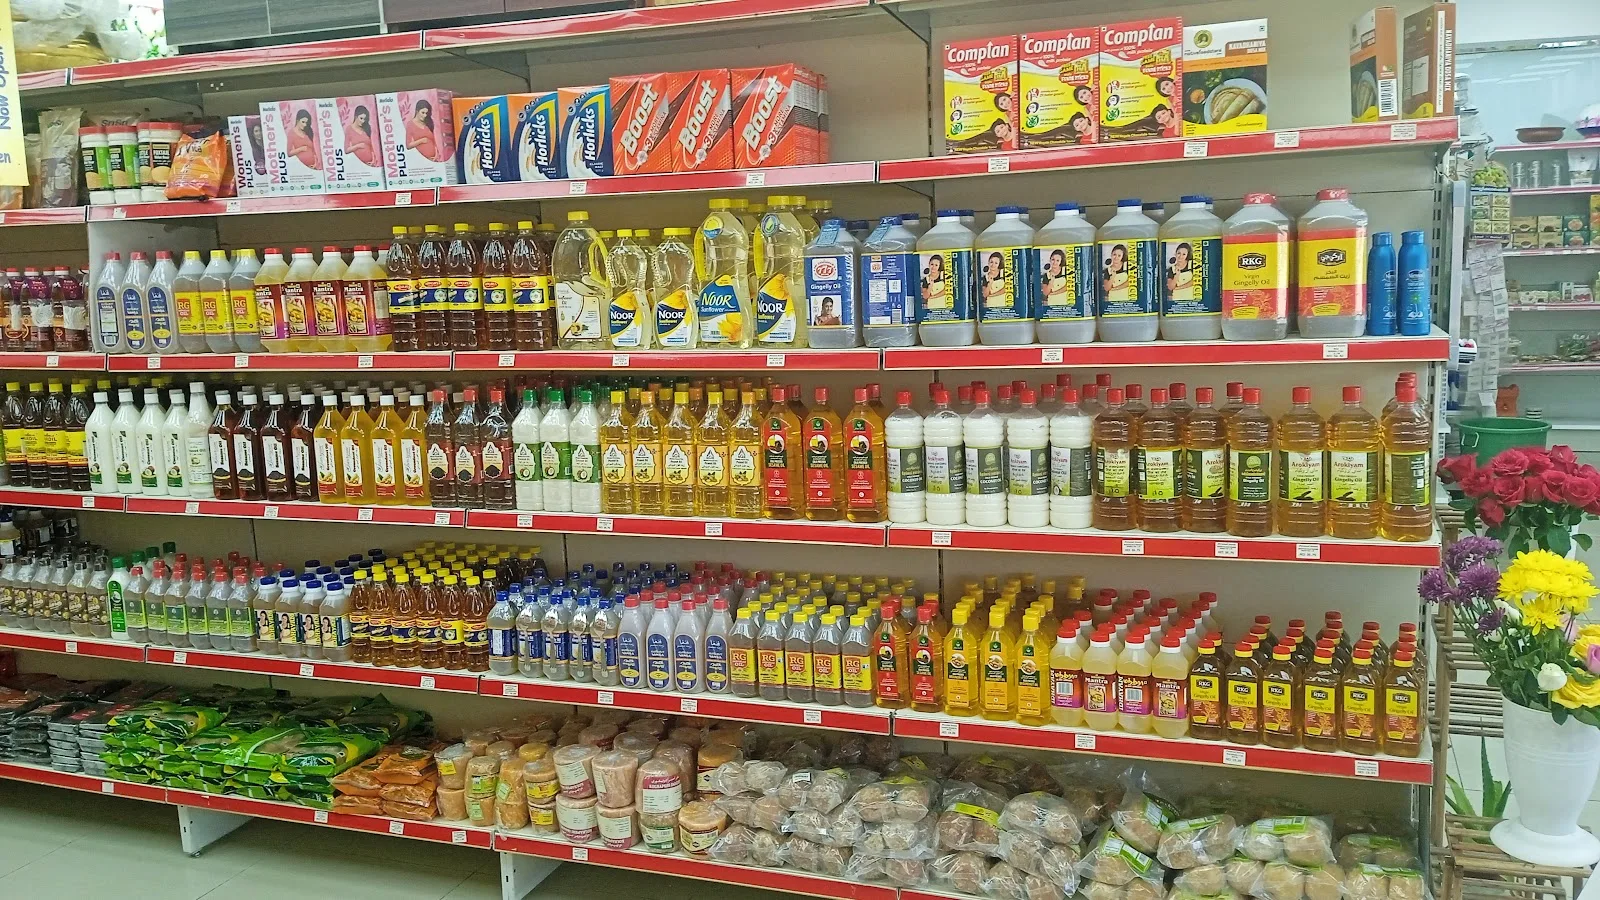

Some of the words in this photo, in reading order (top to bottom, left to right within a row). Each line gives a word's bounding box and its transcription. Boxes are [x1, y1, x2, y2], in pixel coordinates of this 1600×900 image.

[1024, 32, 1091, 56] Complan
[1104, 23, 1173, 48] Complan
[948, 41, 1010, 64] Complan
[264, 113, 281, 184] Mother's
[319, 110, 337, 182] Mother's
[380, 105, 398, 178] Mother's
[482, 118, 494, 169] Horlicks
[536, 114, 548, 166] Horlicks
[585, 108, 596, 161] Horlicks
[232, 126, 246, 189] Women's
[278, 151, 288, 183] PLUS
[335, 148, 345, 181] PLUS
[397, 144, 407, 177] PLUS
[244, 159, 254, 188] PLUS
[1066, 247, 1076, 305] IDHAYAM
[1128, 242, 1137, 300] IDHAYAM
[1193, 239, 1202, 301] IDHAYAM
[1241, 257, 1263, 266] RKG
[810, 283, 832, 291] Gingelly
[944, 252, 954, 309] IDHAYAM
[1004, 249, 1014, 307] IDHAYAM
[178, 301, 190, 309] RG
[203, 301, 216, 309] RG
[233, 299, 246, 308] RG
[658, 309, 685, 319] NOOR
[701, 291, 736, 308] NOOR
[610, 311, 634, 320] NOOR
[732, 653, 746, 661] RG
[817, 659, 831, 667] RG
[1085, 676, 1108, 684] Mantra
[1156, 682, 1181, 690] Mantra
